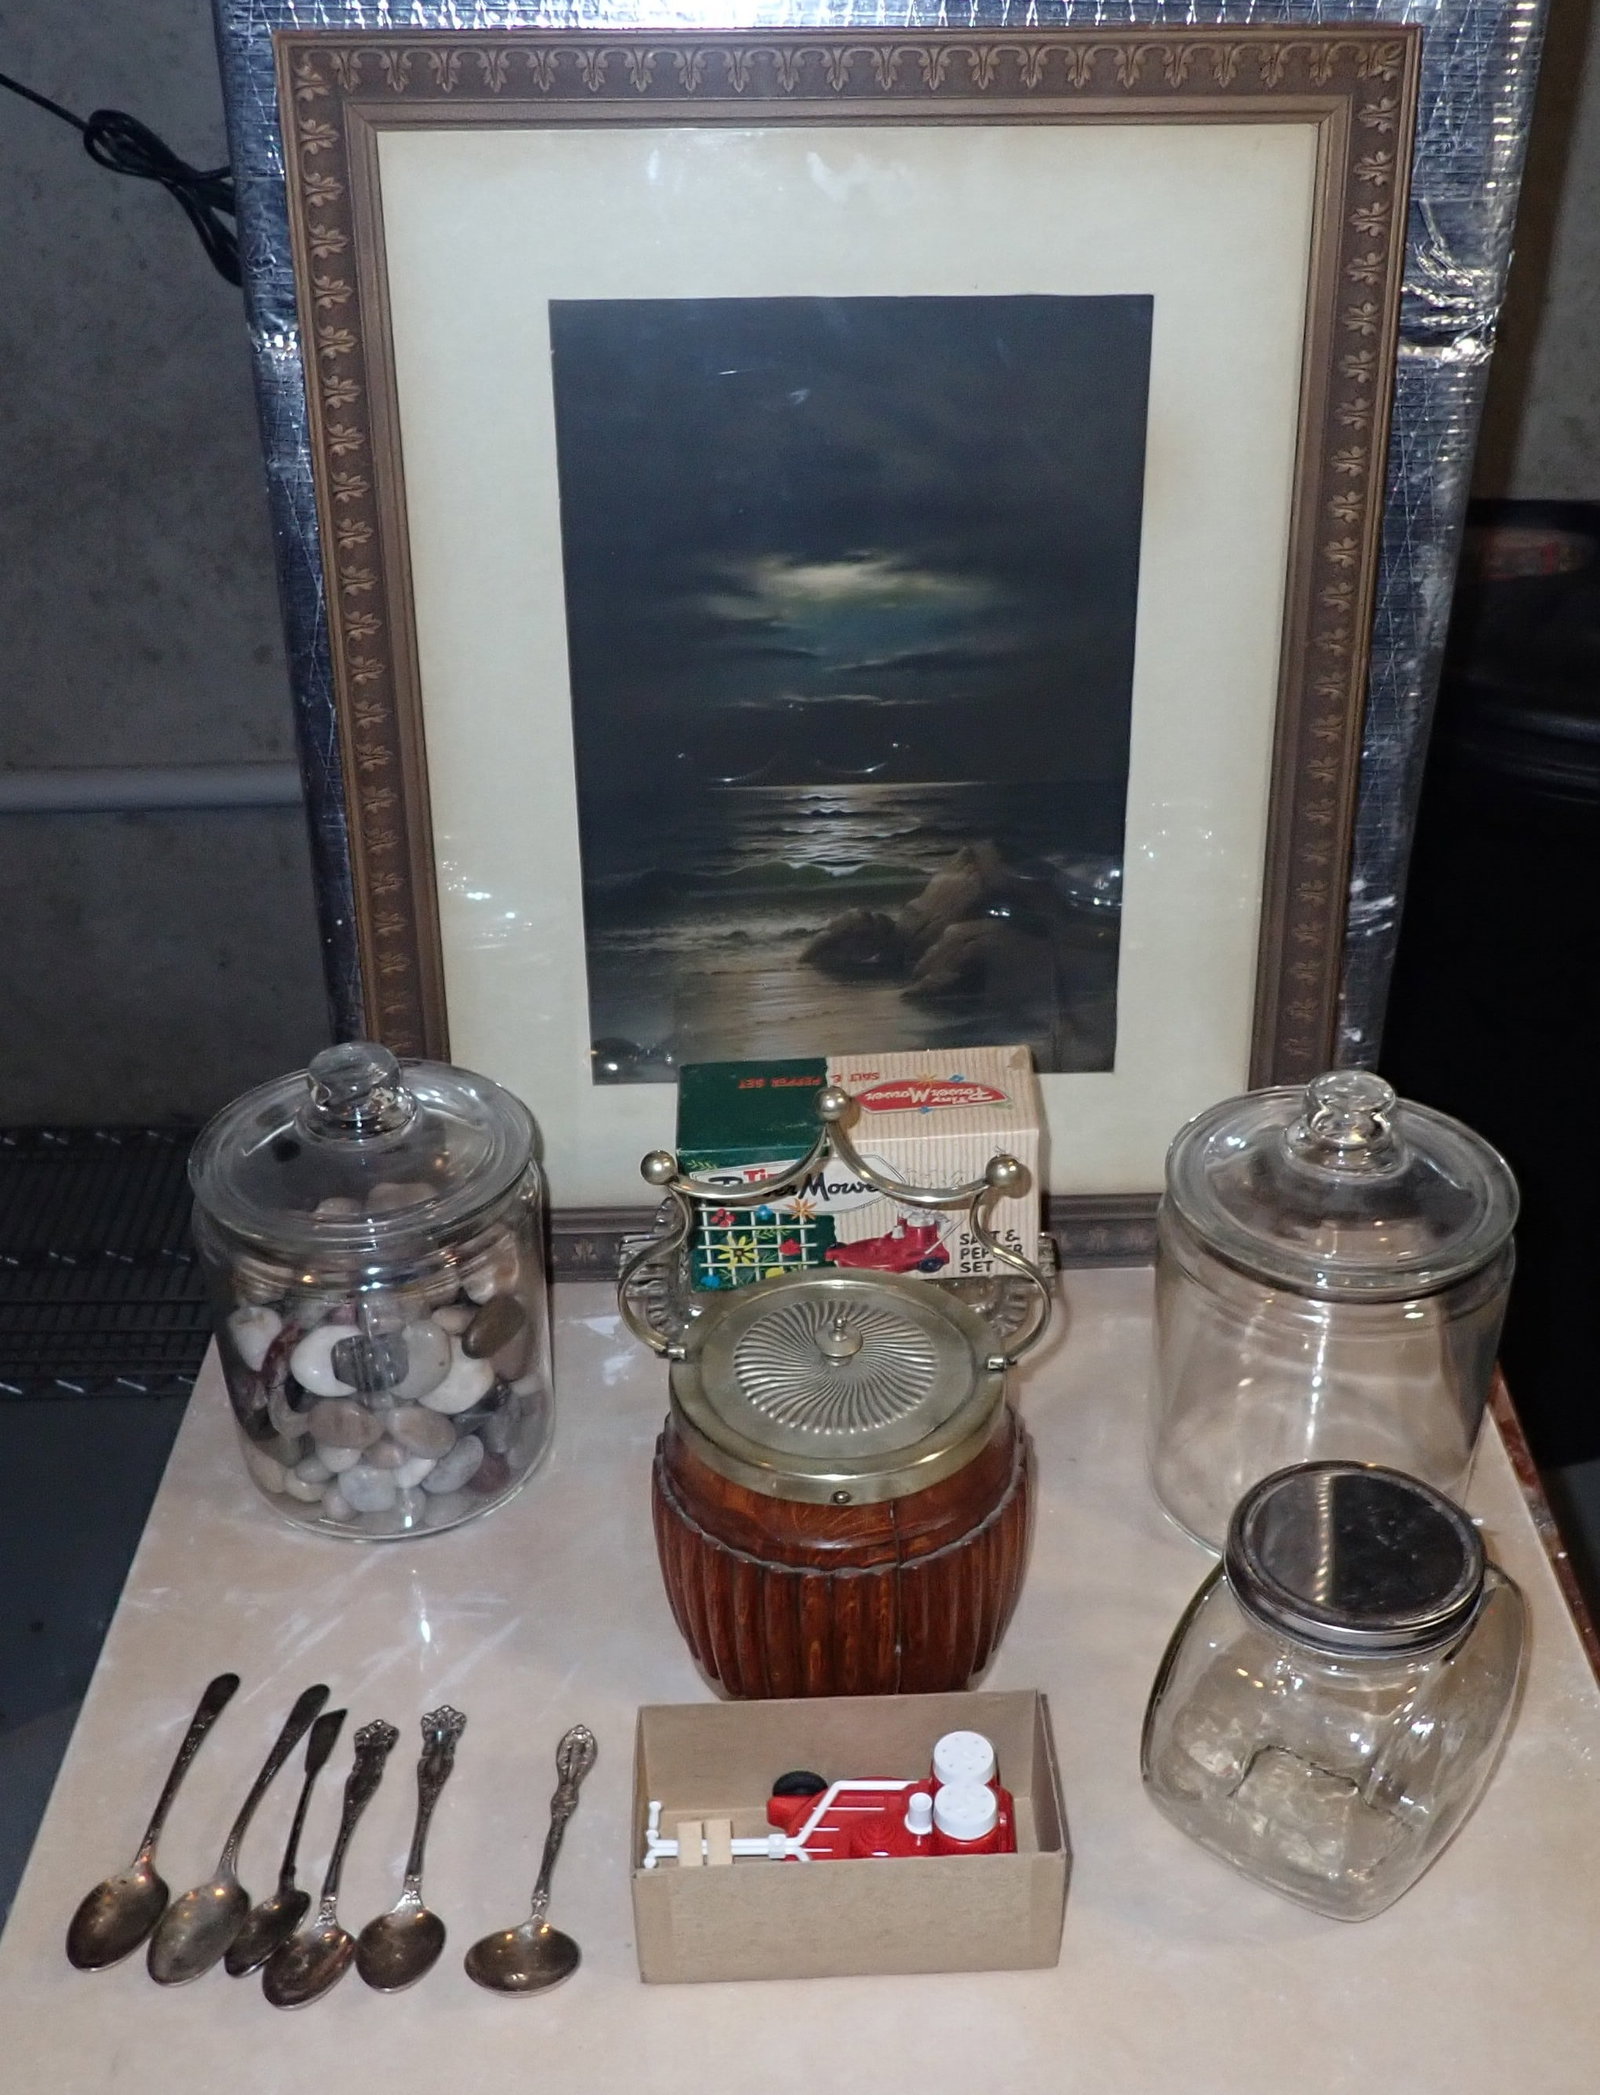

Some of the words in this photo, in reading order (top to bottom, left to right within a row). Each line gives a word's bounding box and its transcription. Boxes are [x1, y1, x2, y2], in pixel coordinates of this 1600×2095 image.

[737, 1077, 765, 1089] SET
[771, 1076, 821, 1088] PEPPER
[849, 1072, 880, 1082] SALT
[865, 1087, 930, 1104] Mower
[931, 1086, 993, 1101] Power
[798, 1172, 880, 1201] Mowe
[1005, 1229, 1020, 1242] &
[960, 1260, 994, 1273] SET
